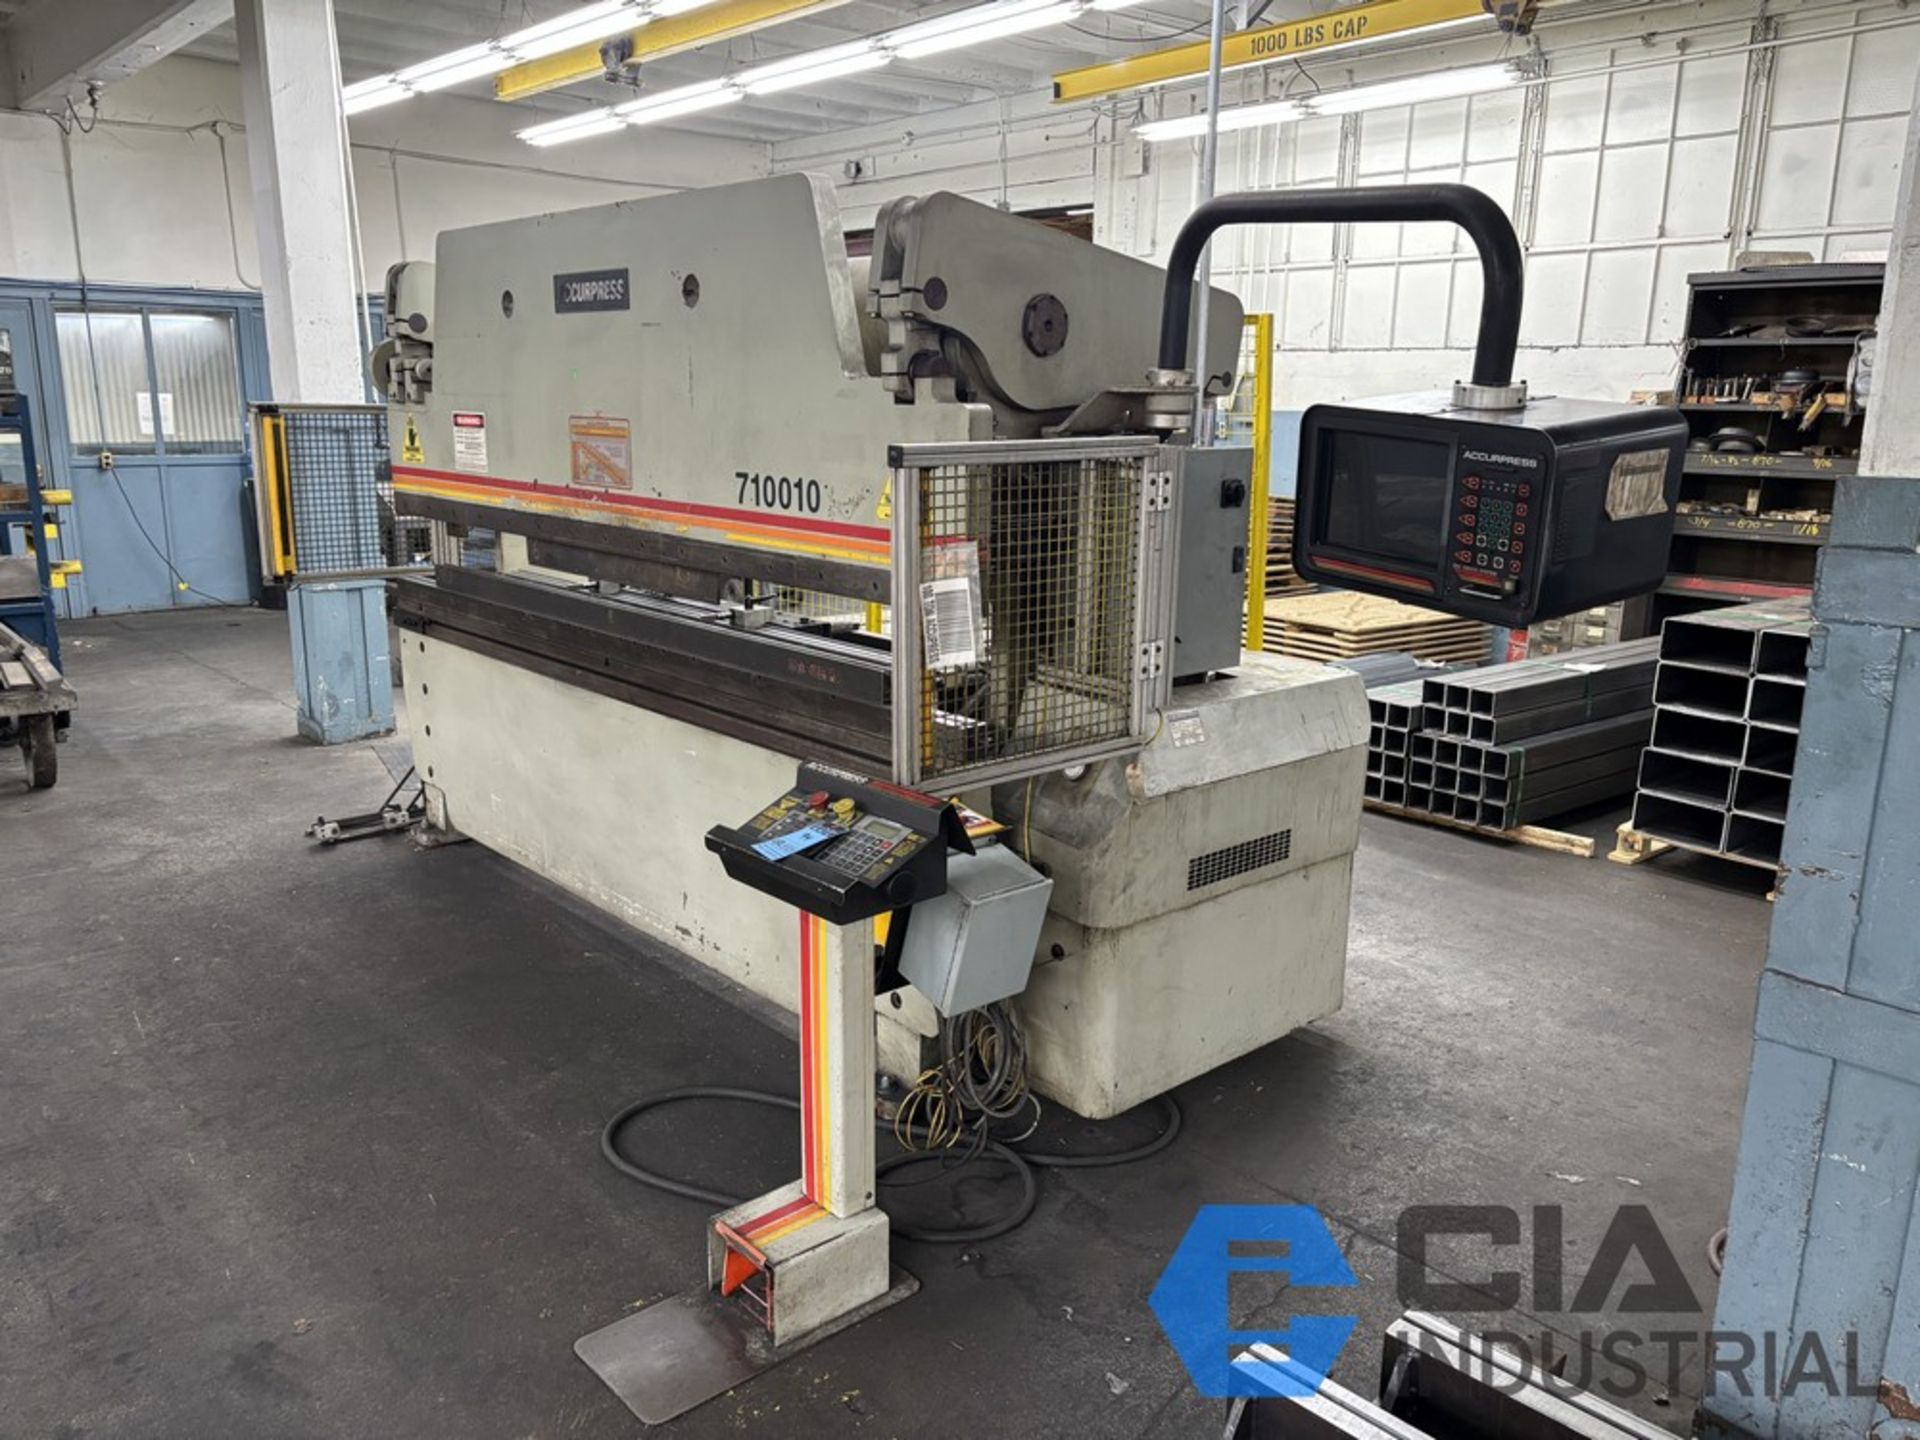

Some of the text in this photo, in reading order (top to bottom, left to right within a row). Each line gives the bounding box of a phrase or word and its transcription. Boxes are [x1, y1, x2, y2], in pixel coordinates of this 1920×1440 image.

[1250, 16, 1368, 55] 1000 LBS CAP
[735, 472, 821, 513] 710010
